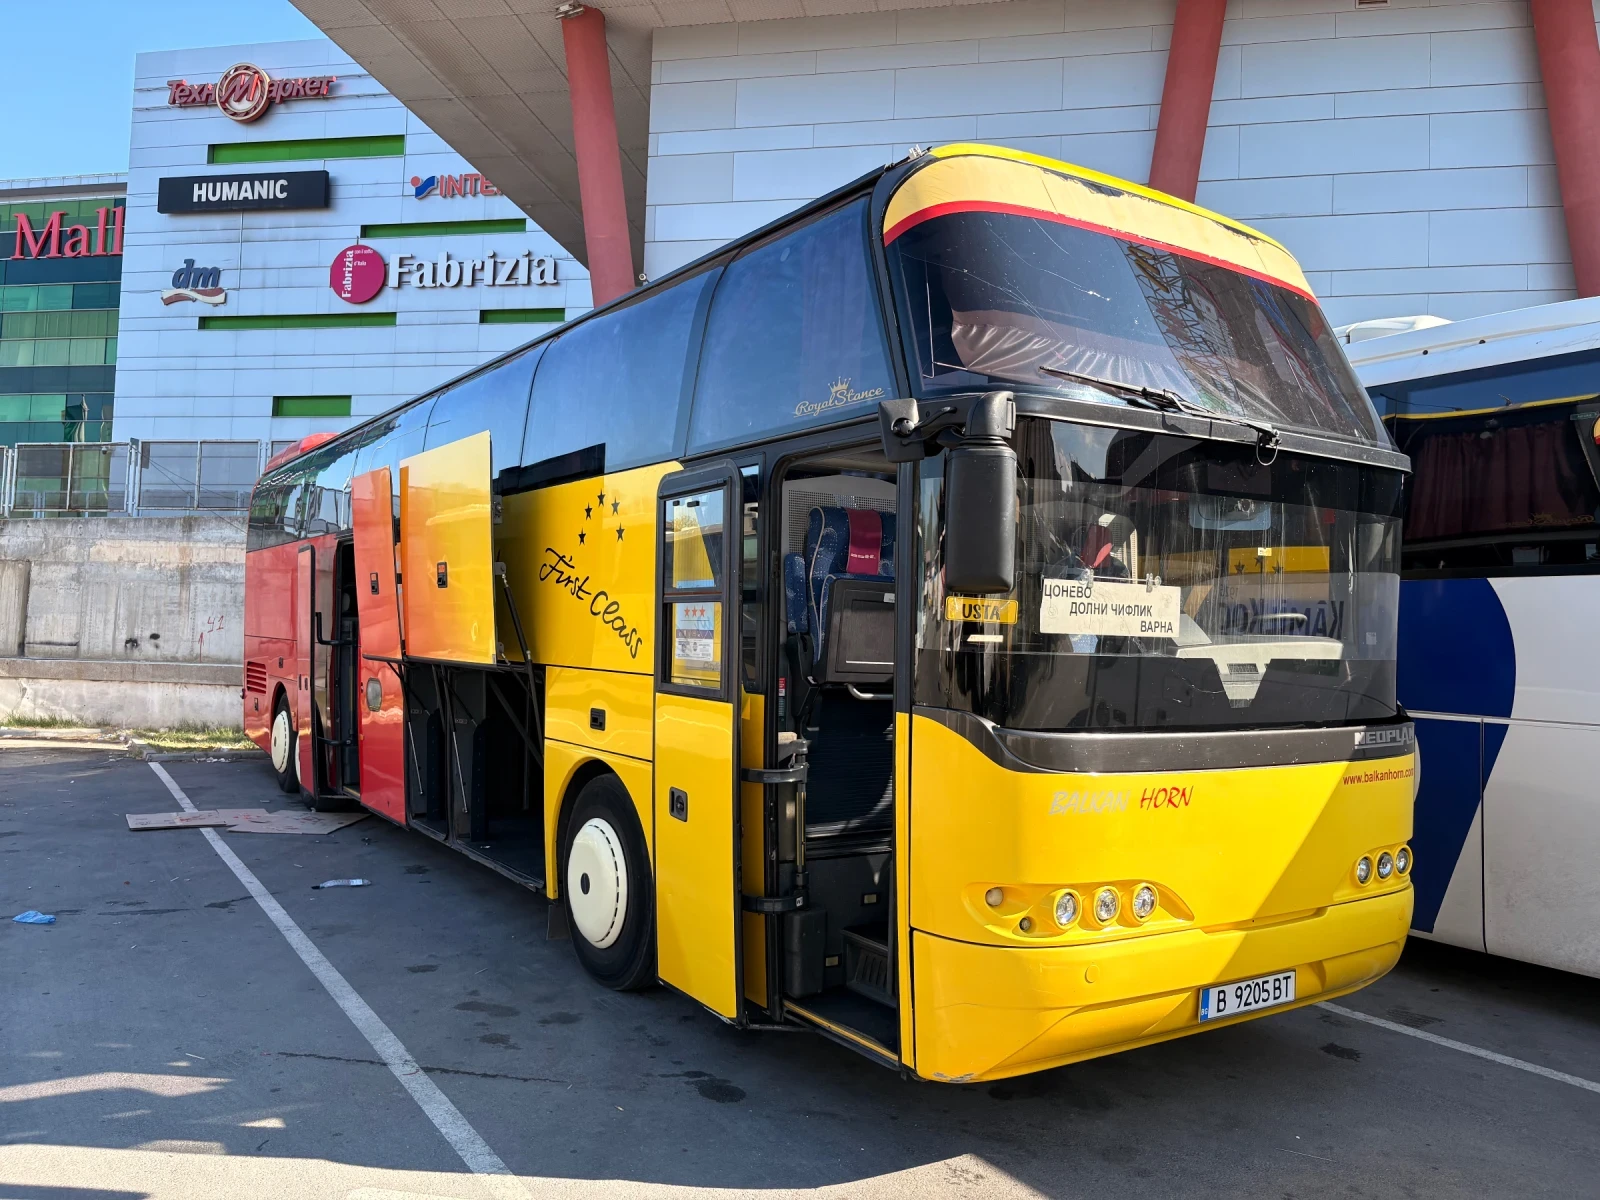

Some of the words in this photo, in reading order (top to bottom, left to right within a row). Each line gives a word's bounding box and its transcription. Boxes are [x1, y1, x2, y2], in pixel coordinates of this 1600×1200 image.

[193, 179, 288, 203] HUMANIC
[439, 173, 502, 198] INTE
[11, 206, 124, 260] Mall
[171, 258, 221, 289] dm
[341, 249, 354, 298] Fabrizia
[388, 250, 558, 289] Fabrizia
[1044, 584, 1092, 600] ЦОНЕВО
[961, 602, 1001, 620] USTA
[1069, 601, 1109, 617] ДОЛНИ
[1111, 603, 1153, 618] ЧИФЛИК
[590, 590, 643, 660] Class
[1140, 619, 1174, 634] ВАРНА
[1354, 726, 1415, 749] NEOPLAN
[1048, 789, 1132, 816] BALKAN
[1139, 786, 1194, 810] HORN
[1216, 989, 1227, 1013] B
